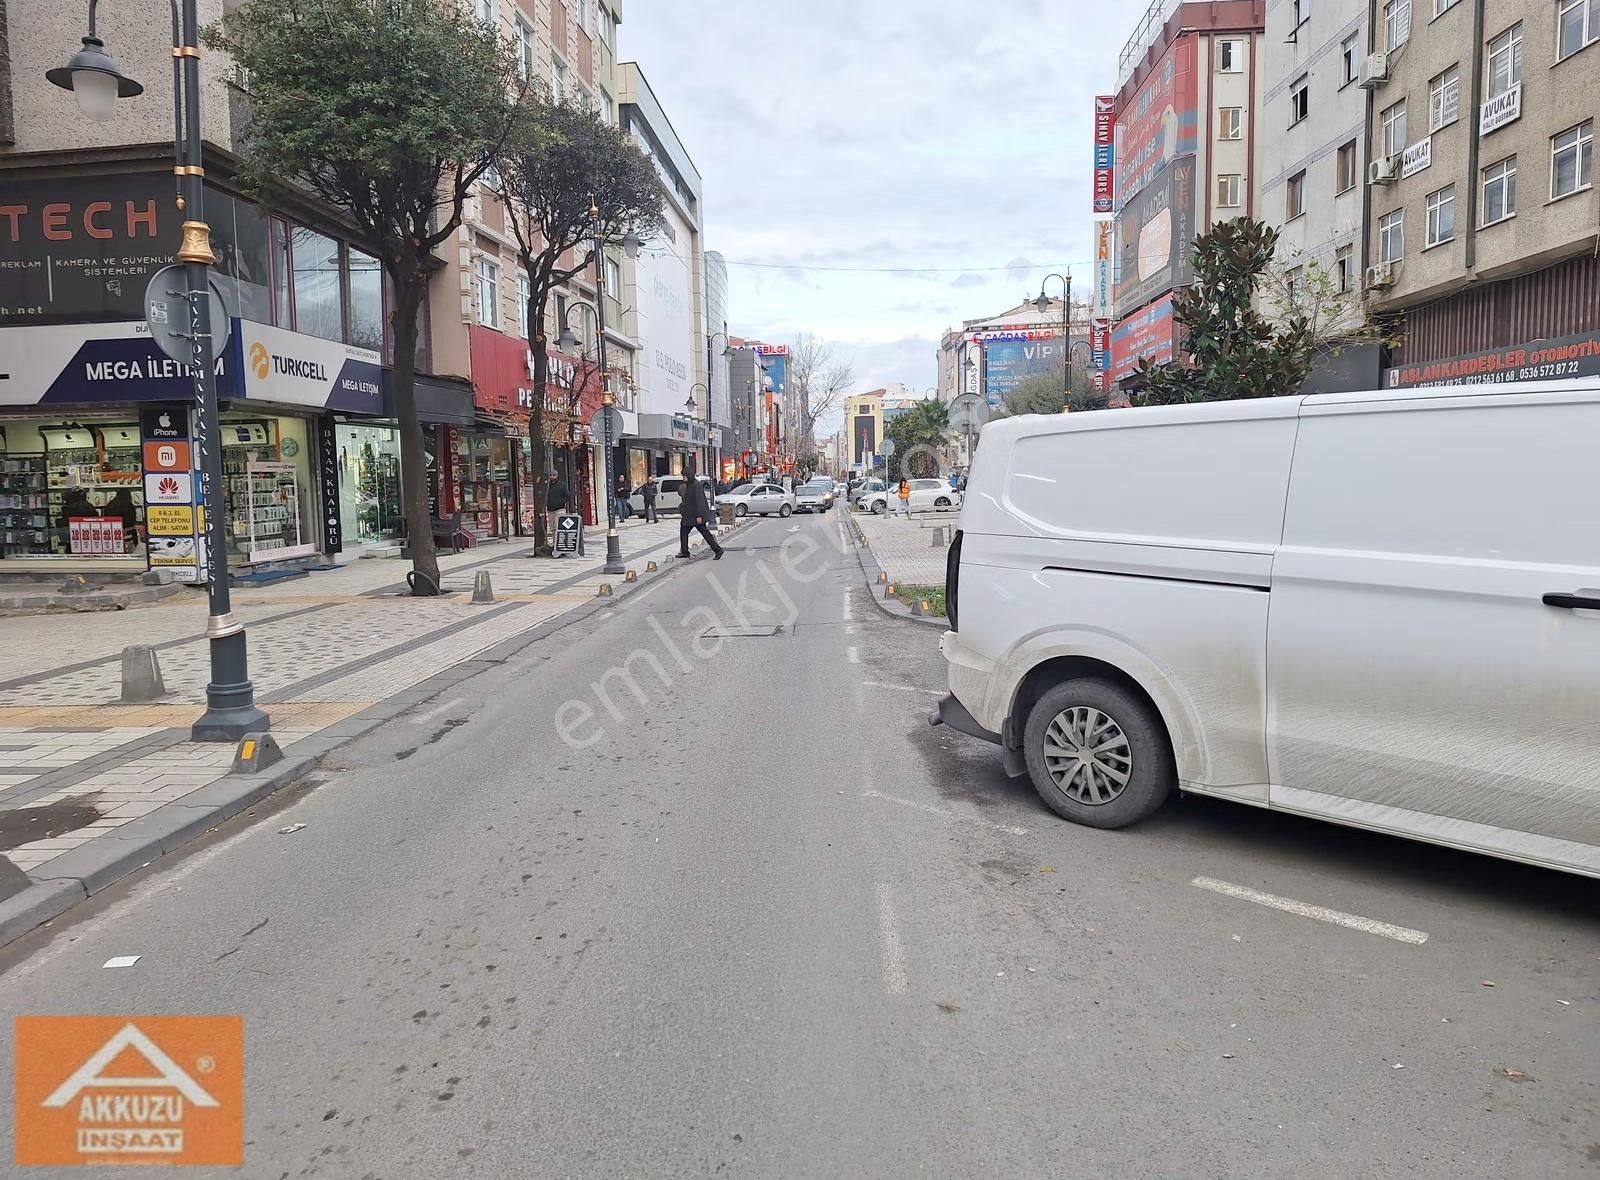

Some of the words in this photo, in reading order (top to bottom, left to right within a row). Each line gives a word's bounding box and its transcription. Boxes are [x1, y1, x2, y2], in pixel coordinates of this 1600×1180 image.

[1483, 90, 1517, 120] AVUKAT
[1098, 115, 1109, 143] SINAV
[1403, 141, 1430, 168] AVUKAT
[1097, 170, 1109, 193] KURS
[1, 261, 41, 269] REKLAM
[56, 258, 98, 267] KAMERA
[103, 257, 116, 265] VE
[86, 360, 143, 381] MEGA
[147, 355, 225, 378] İLETİM
[272, 354, 328, 381] TURKCELL
[1401, 349, 1526, 384] ASLANKARDEŞLER
[1466, 374, 1481, 385] 0212
[1482, 373, 1494, 384] 563
[1496, 371, 1504, 383] 61
[1505, 370, 1515, 382] 68
[1519, 366, 1539, 380] 0536
[1539, 364, 1555, 377] 572
[1556, 362, 1567, 375] 87
[1568, 360, 1579, 373] 22
[342, 379, 358, 391] MEGA
[323, 430, 334, 475] BAYAN
[202, 472, 216, 596] BELEDİYESİ
